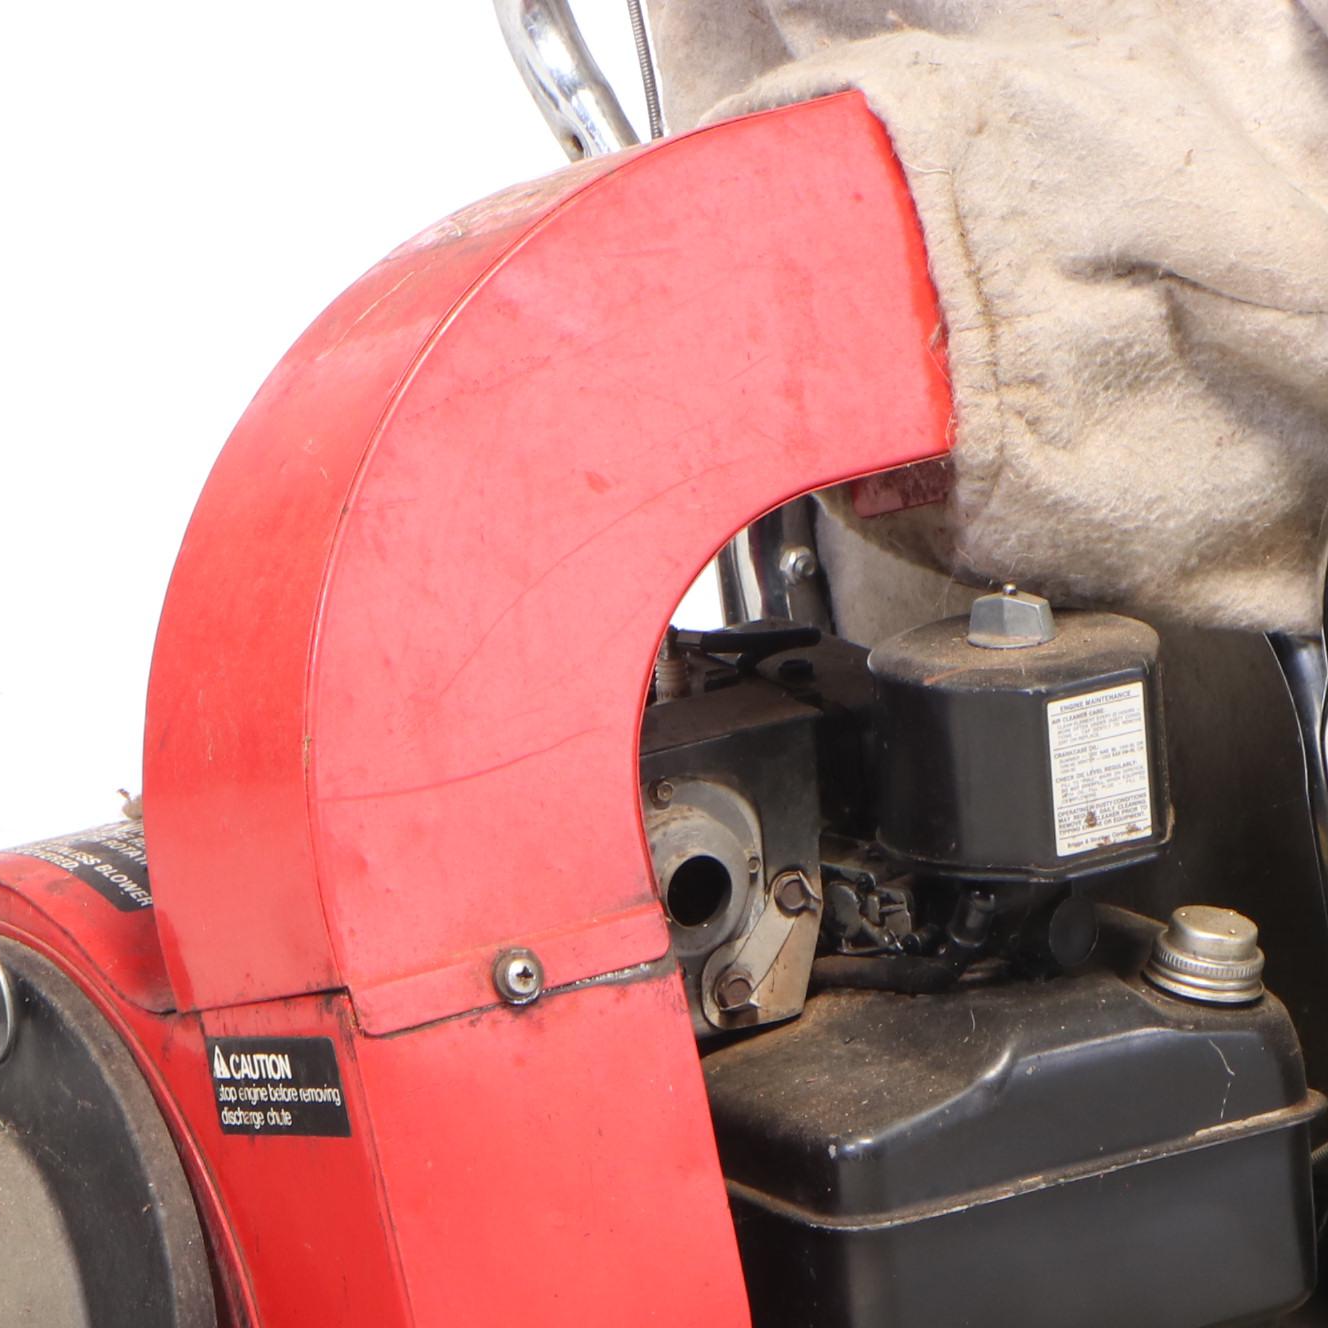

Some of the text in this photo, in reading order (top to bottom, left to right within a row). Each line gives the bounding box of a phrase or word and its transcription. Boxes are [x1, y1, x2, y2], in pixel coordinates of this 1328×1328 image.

[1059, 690, 1130, 712] ENGINE MAINTENANCE
[1063, 711, 1087, 722] CLEANER
[1086, 768, 1101, 776] LEVEL
[94, 864, 153, 907] BLOWER
[229, 1053, 292, 1080] CAUTION
[219, 1083, 341, 1106] stop engine before removing
[221, 1106, 293, 1129] discharge chute
